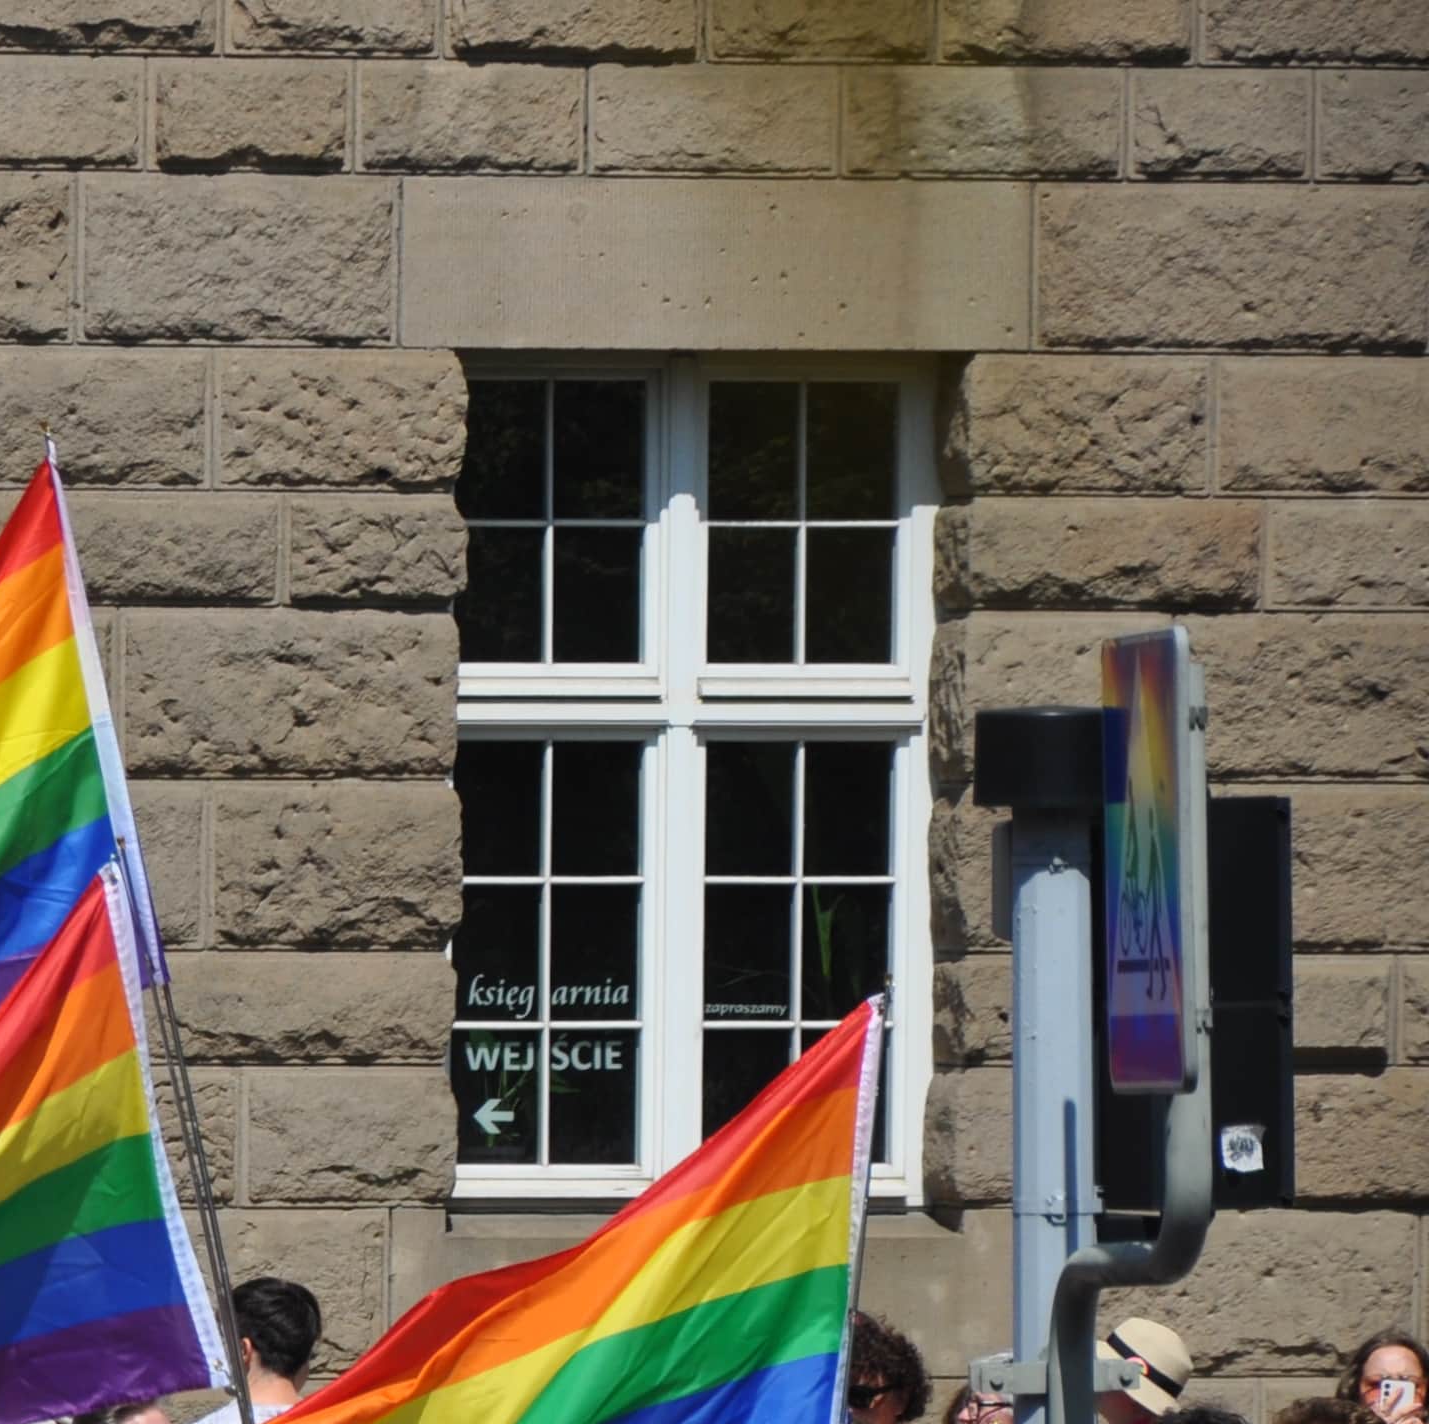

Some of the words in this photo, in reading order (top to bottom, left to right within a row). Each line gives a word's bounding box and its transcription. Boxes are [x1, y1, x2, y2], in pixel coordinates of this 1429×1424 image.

[468, 973, 630, 1019] księgarnia
[704, 1002, 788, 1017] zapraszamy
[465, 1033, 623, 1072] WEJŚCIE
